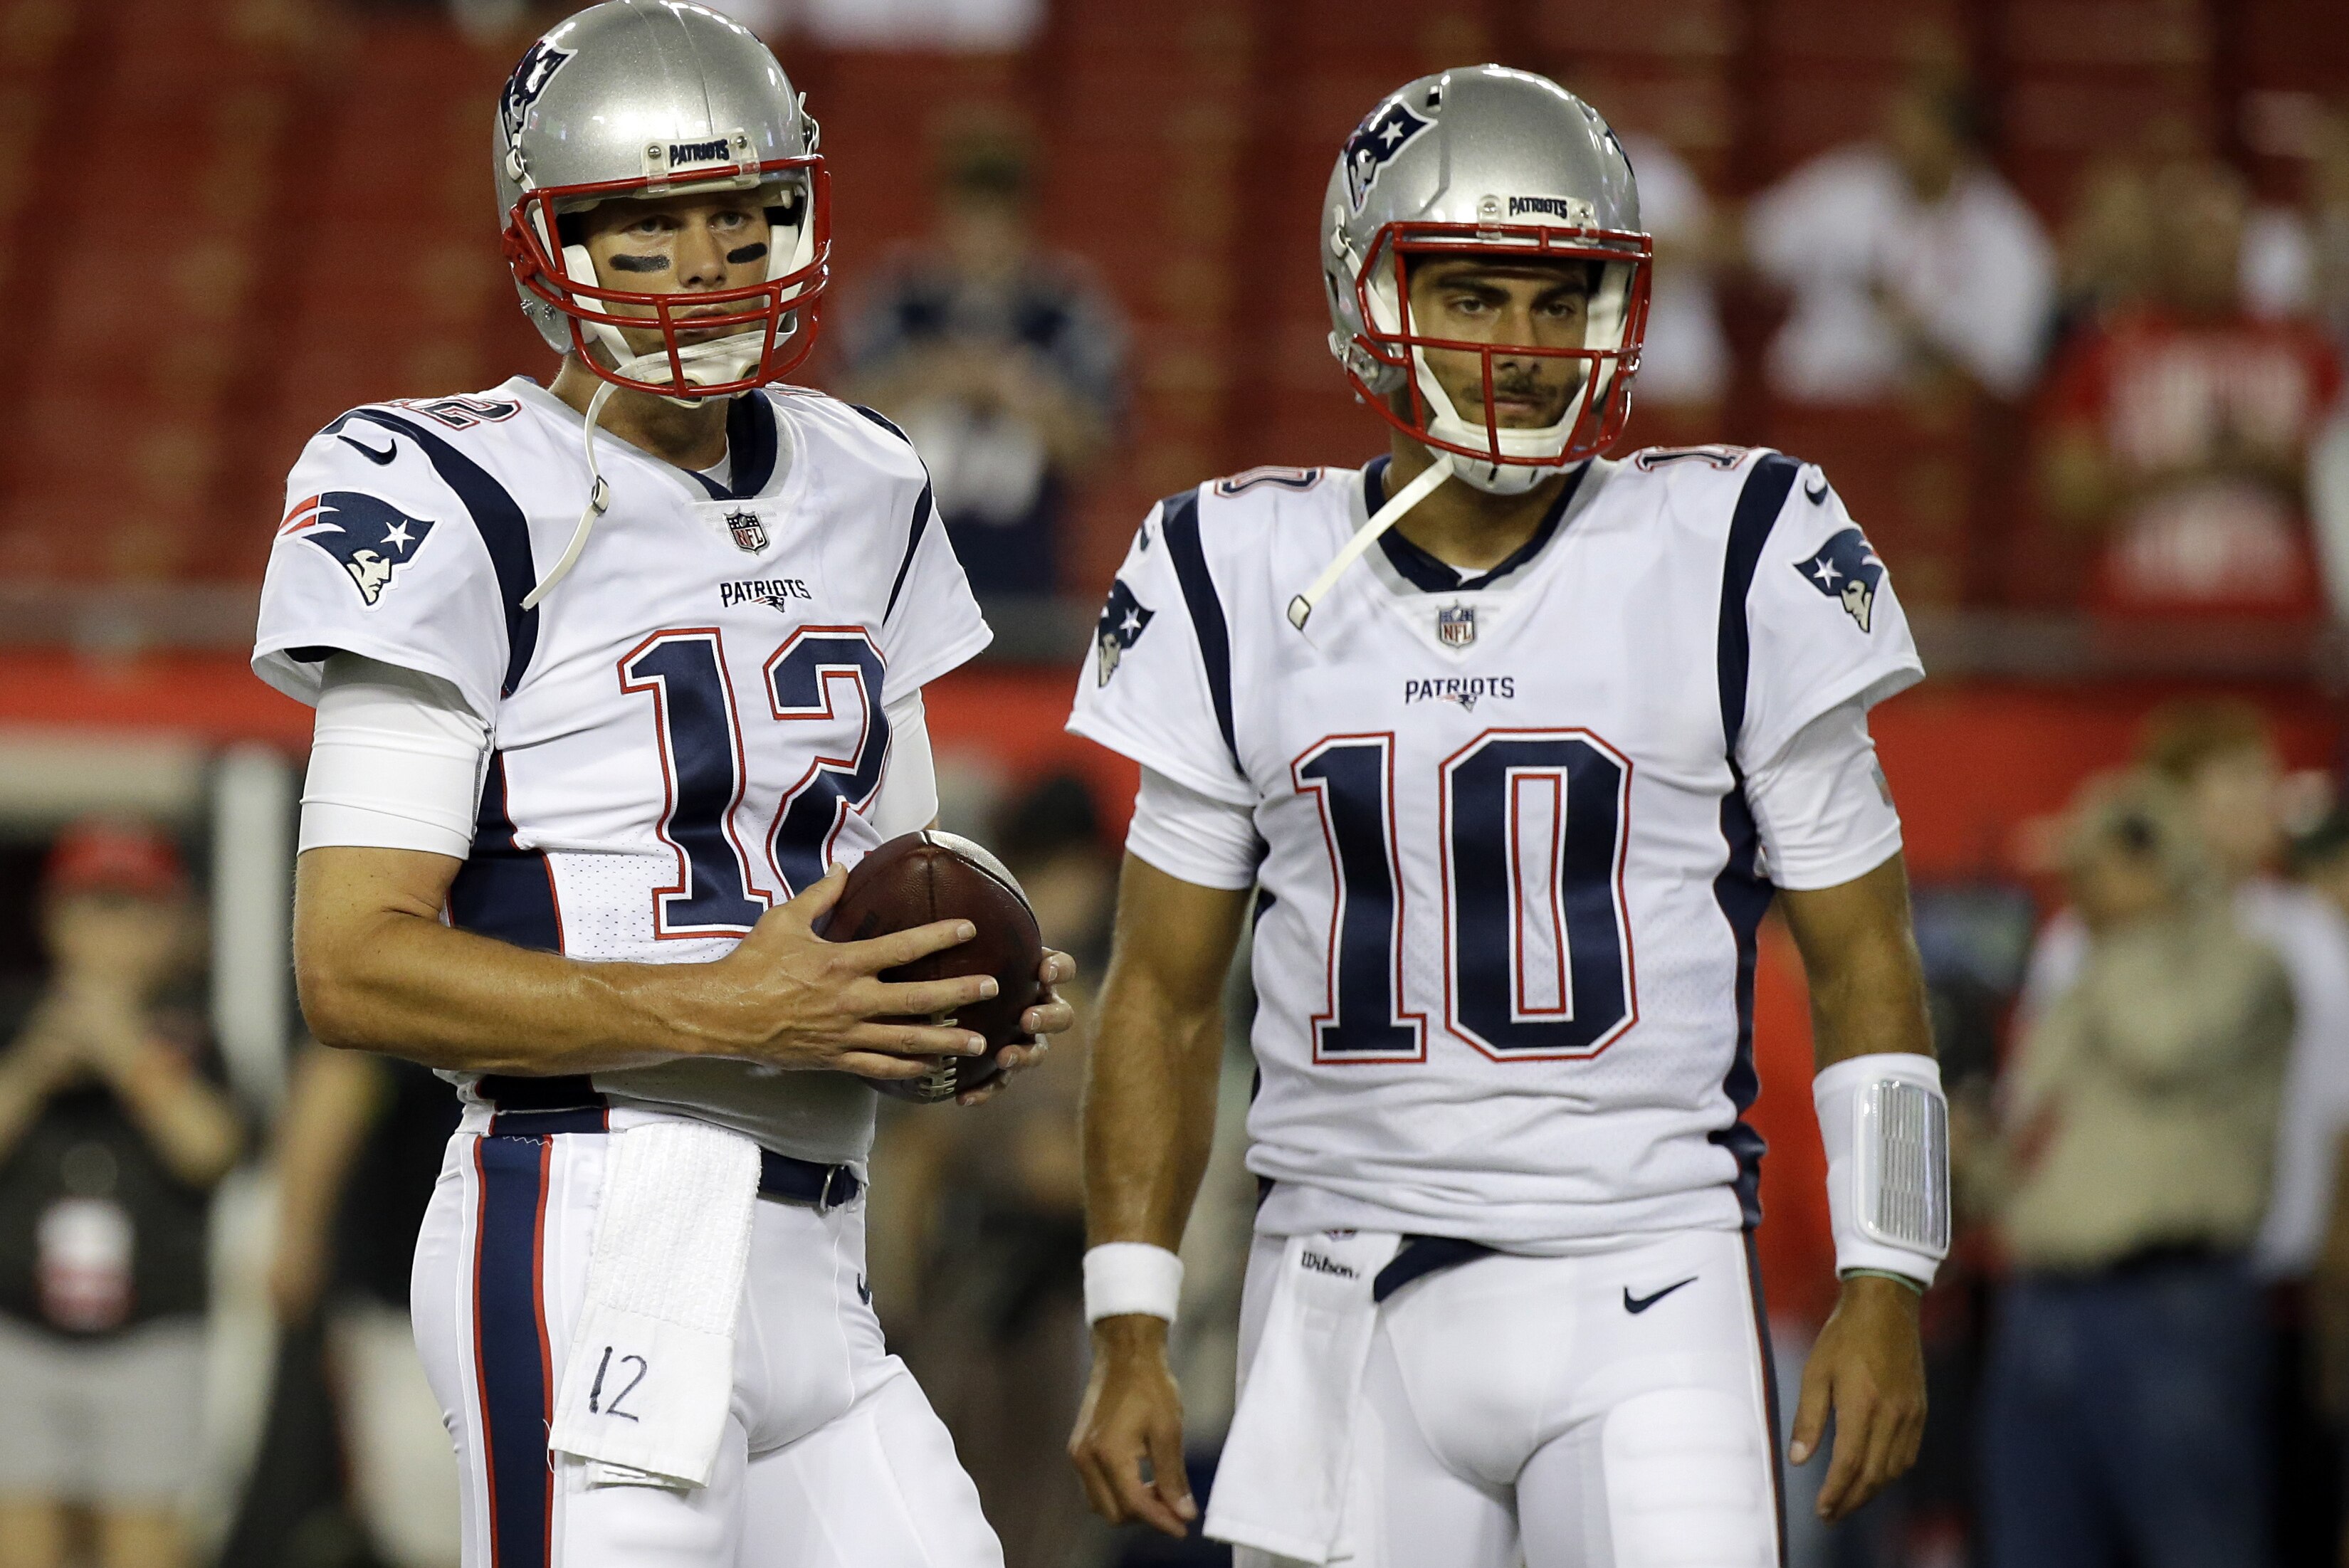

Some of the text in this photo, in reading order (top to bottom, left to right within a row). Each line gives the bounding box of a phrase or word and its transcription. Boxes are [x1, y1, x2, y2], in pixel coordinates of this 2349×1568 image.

[669, 138, 730, 167] PATRIOTS
[1509, 196, 1567, 219] PATRIOTS
[735, 527, 764, 547] NFL
[720, 579, 812, 608] PATRIOTS
[1443, 623, 1471, 641] NFL
[1405, 677, 1515, 705] PATRIOTS
[616, 624, 893, 940] 12
[1290, 727, 1639, 1065] 10
[589, 1346, 648, 1423] 12
